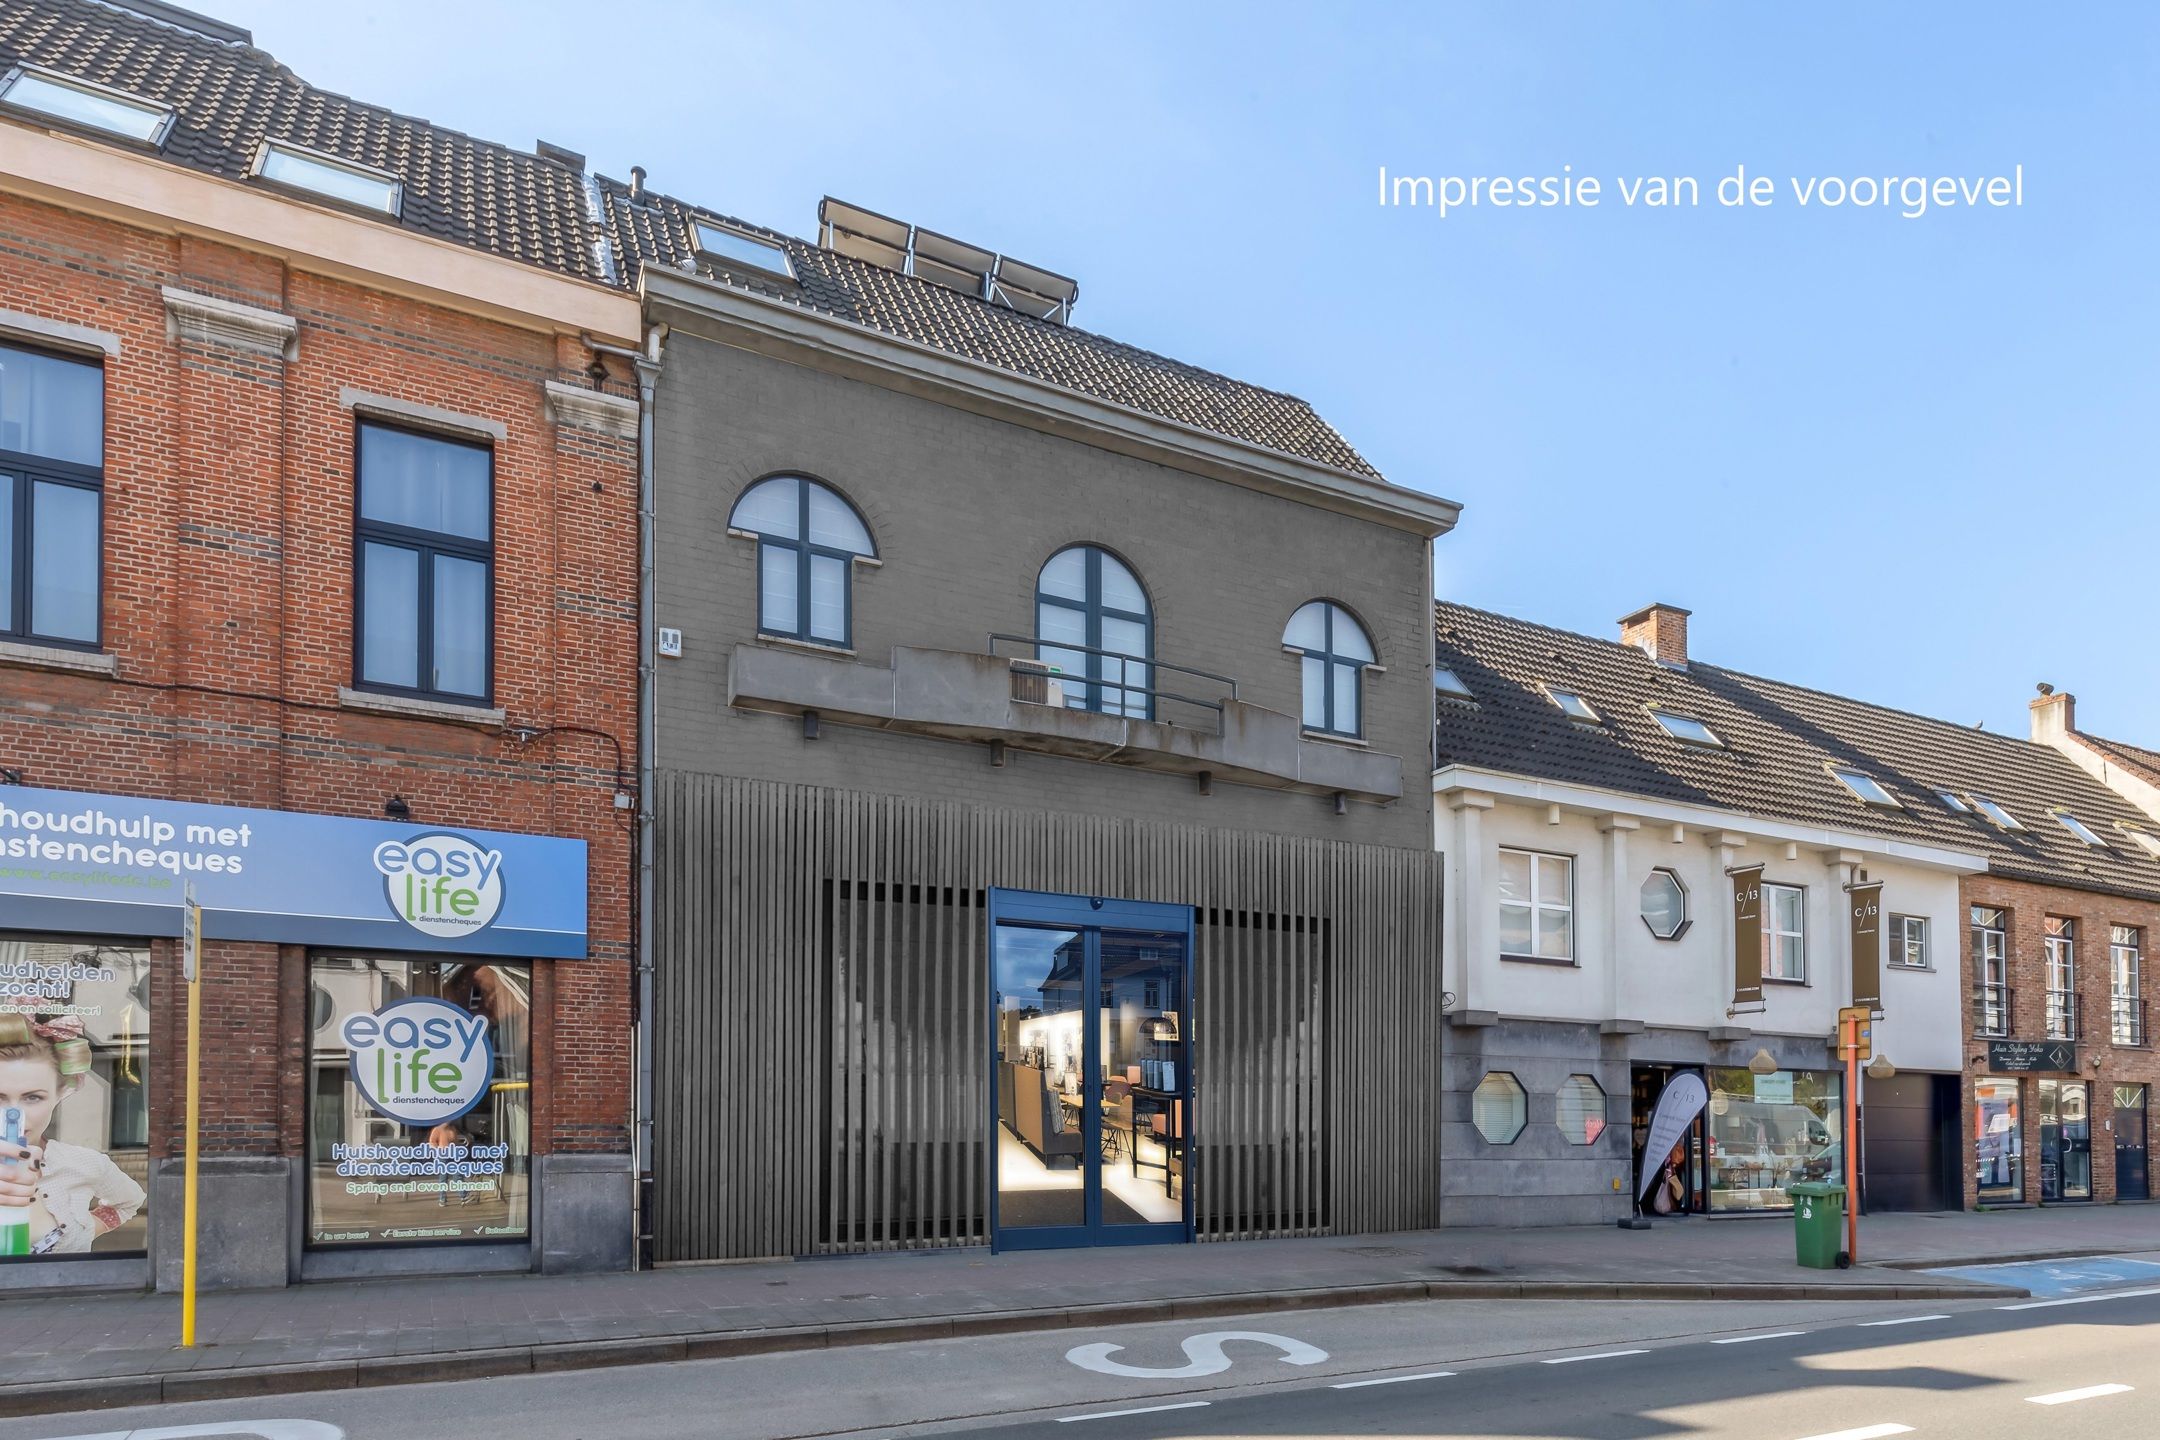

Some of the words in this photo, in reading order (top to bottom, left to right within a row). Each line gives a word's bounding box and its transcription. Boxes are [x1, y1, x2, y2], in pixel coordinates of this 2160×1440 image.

[0, 801, 176, 846] houdhulp
[186, 823, 252, 848] met
[378, 844, 498, 890] easy
[406, 873, 480, 921] life
[1736, 882, 1758, 912] C/13
[418, 915, 482, 926] dienstencheques
[1854, 899, 1877, 927] C/13
[19, 1005, 36, 1014] en
[38, 1004, 102, 1016] solliciteer!
[343, 1015, 484, 1063] easy
[377, 1048, 463, 1104] life
[392, 1096, 466, 1106] dienstencheques
[332, 1143, 468, 1161] Huishoudhulp
[471, 1143, 509, 1159] met
[336, 1159, 503, 1177] dienstencheques
[346, 1181, 388, 1195] Spring
[389, 1181, 417, 1192] snel
[418, 1182, 447, 1192] even
[450, 1180, 495, 1192] binnen!
